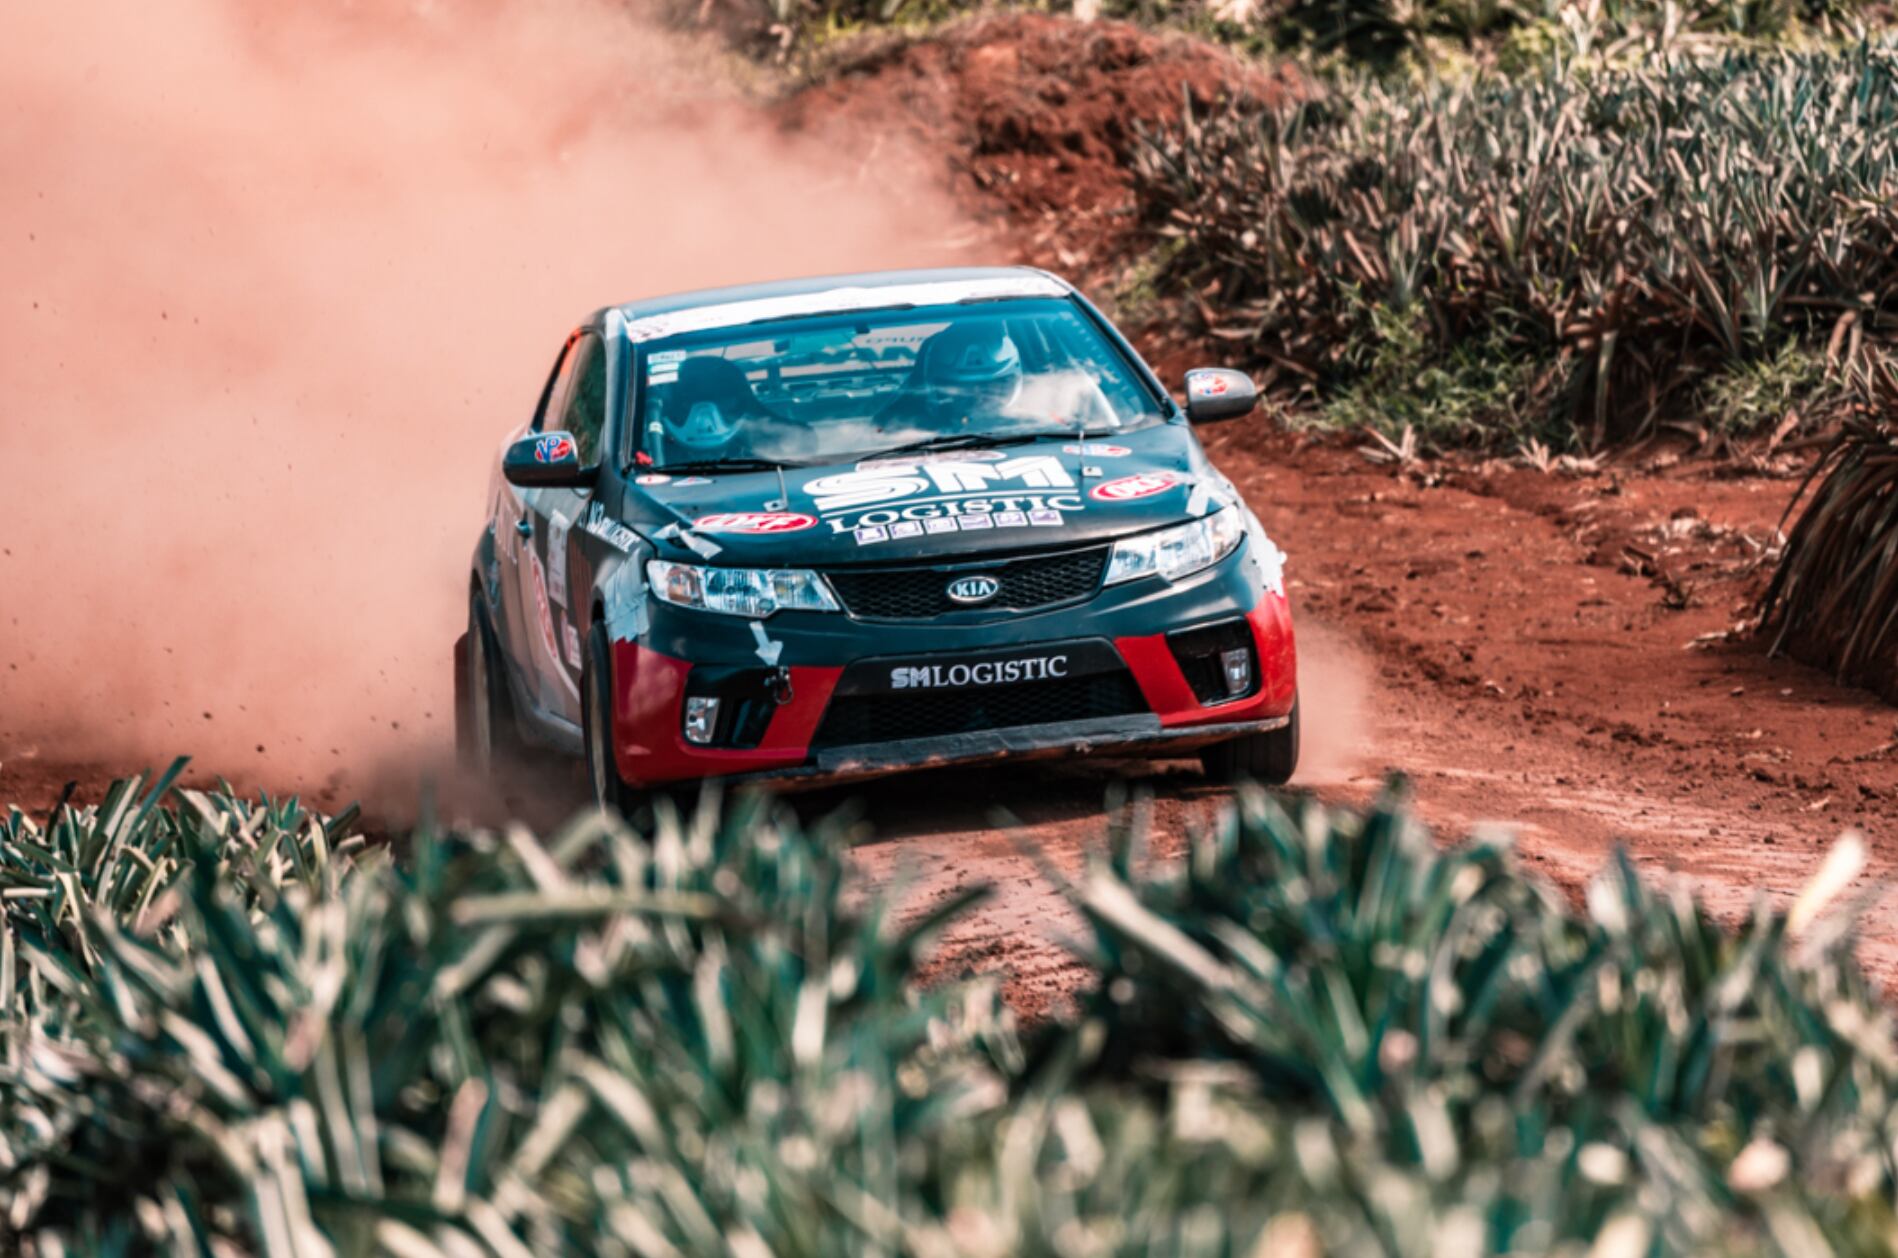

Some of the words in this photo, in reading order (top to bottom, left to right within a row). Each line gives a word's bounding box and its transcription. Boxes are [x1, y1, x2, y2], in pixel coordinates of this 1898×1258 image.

[802, 456, 1075, 511] SM
[826, 495, 1085, 533] LOGISTIC
[956, 581, 991, 597] KIA
